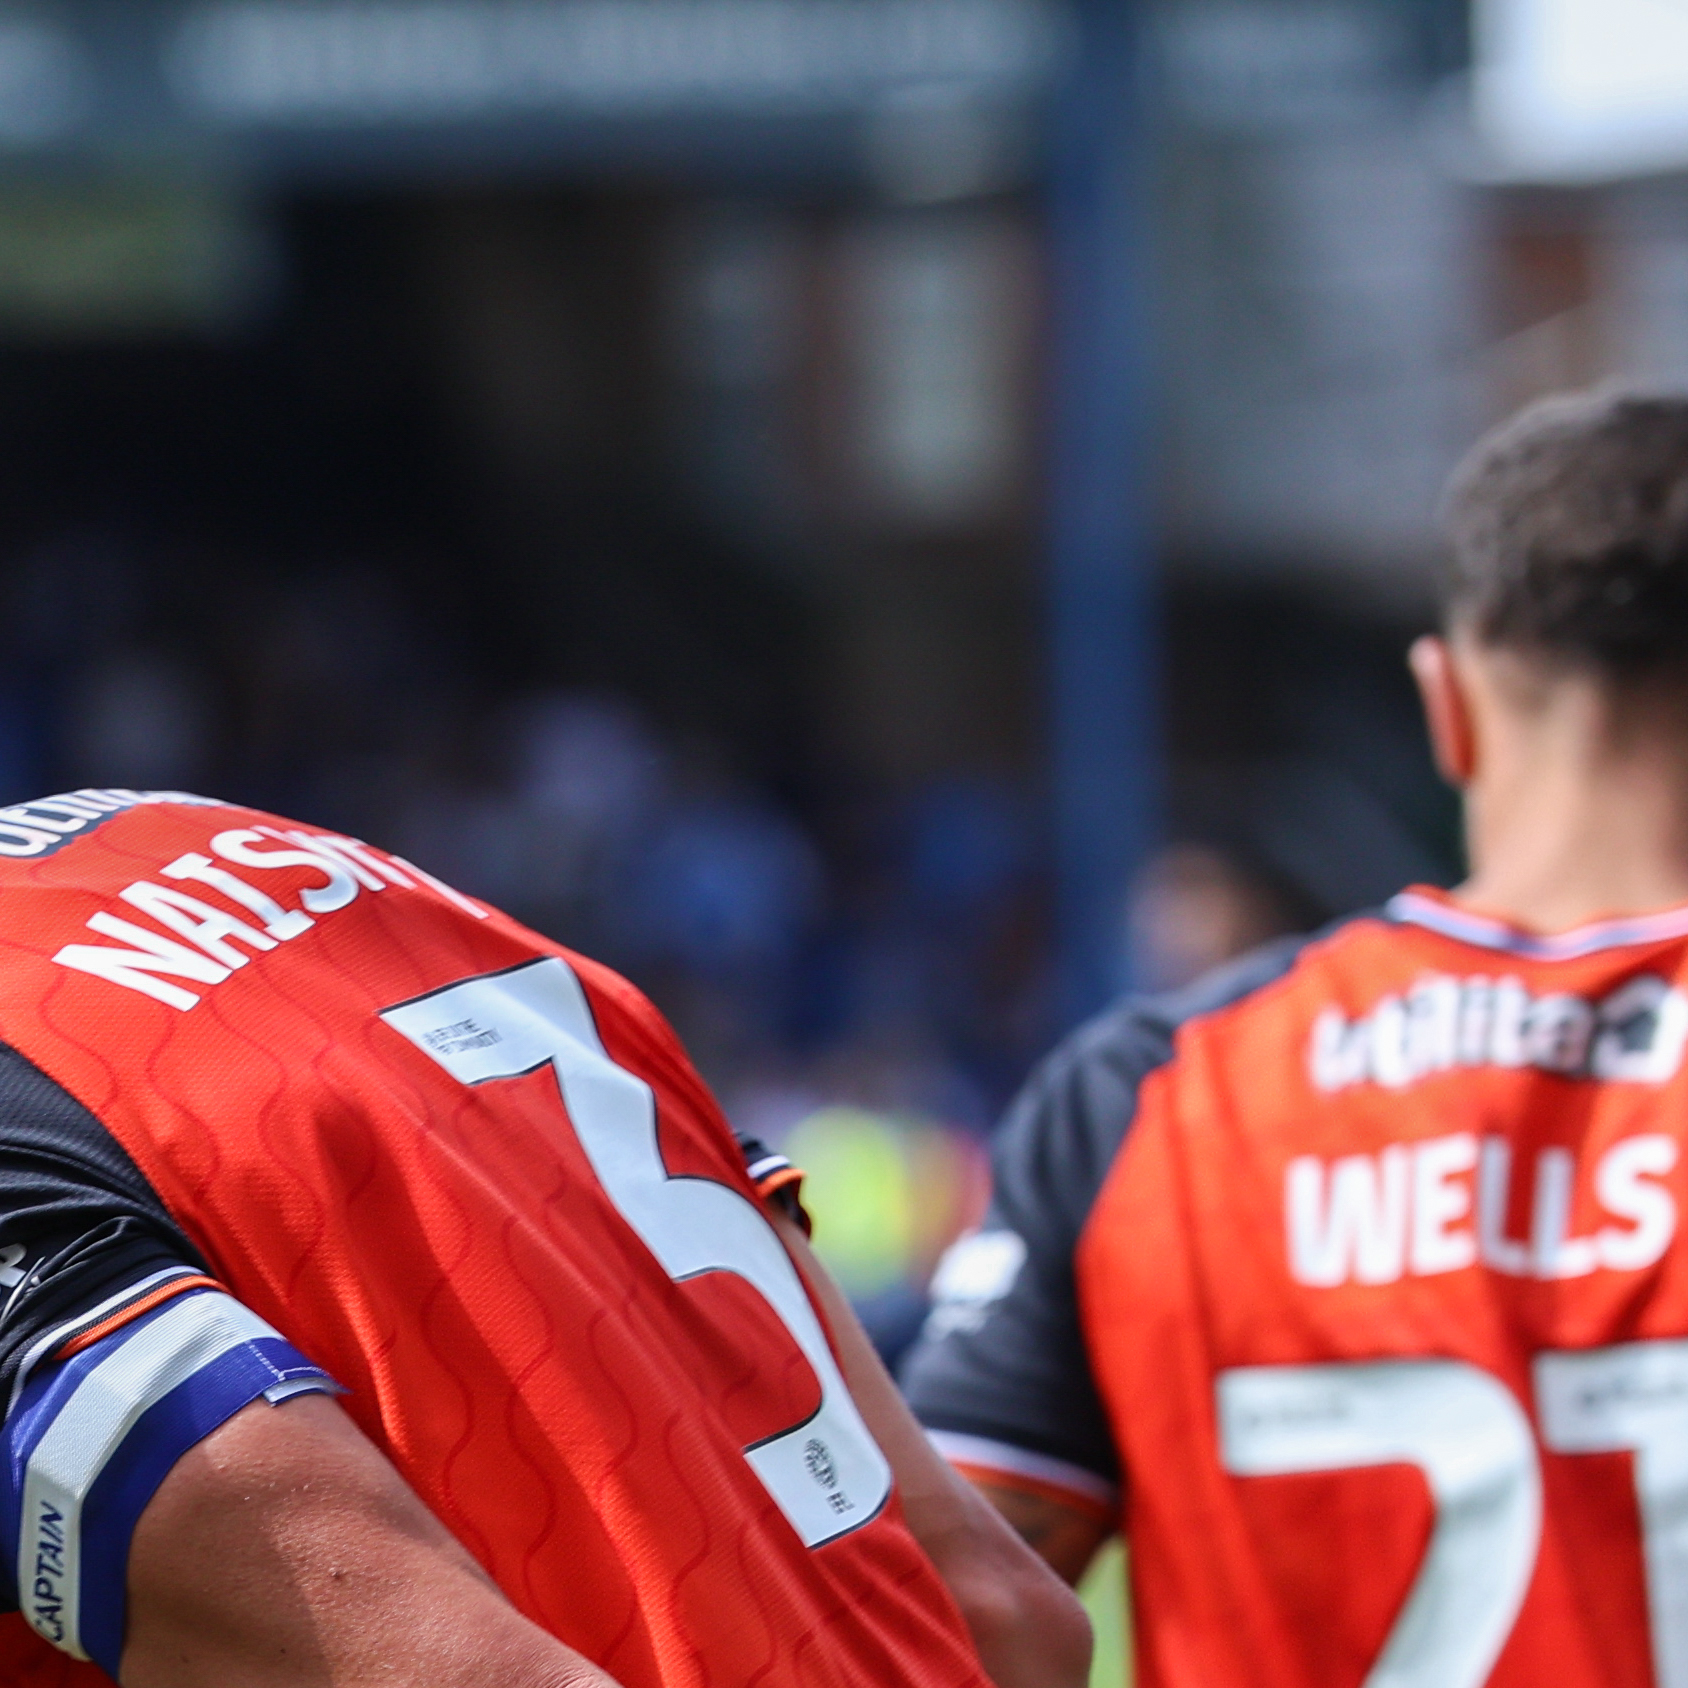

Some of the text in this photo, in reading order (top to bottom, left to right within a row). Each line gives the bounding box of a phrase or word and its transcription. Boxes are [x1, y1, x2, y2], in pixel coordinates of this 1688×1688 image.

[378, 955, 894, 1550] 3
[1284, 1131, 1679, 1288] WELLS
[32, 1500, 64, 1643] CAPTAIN
